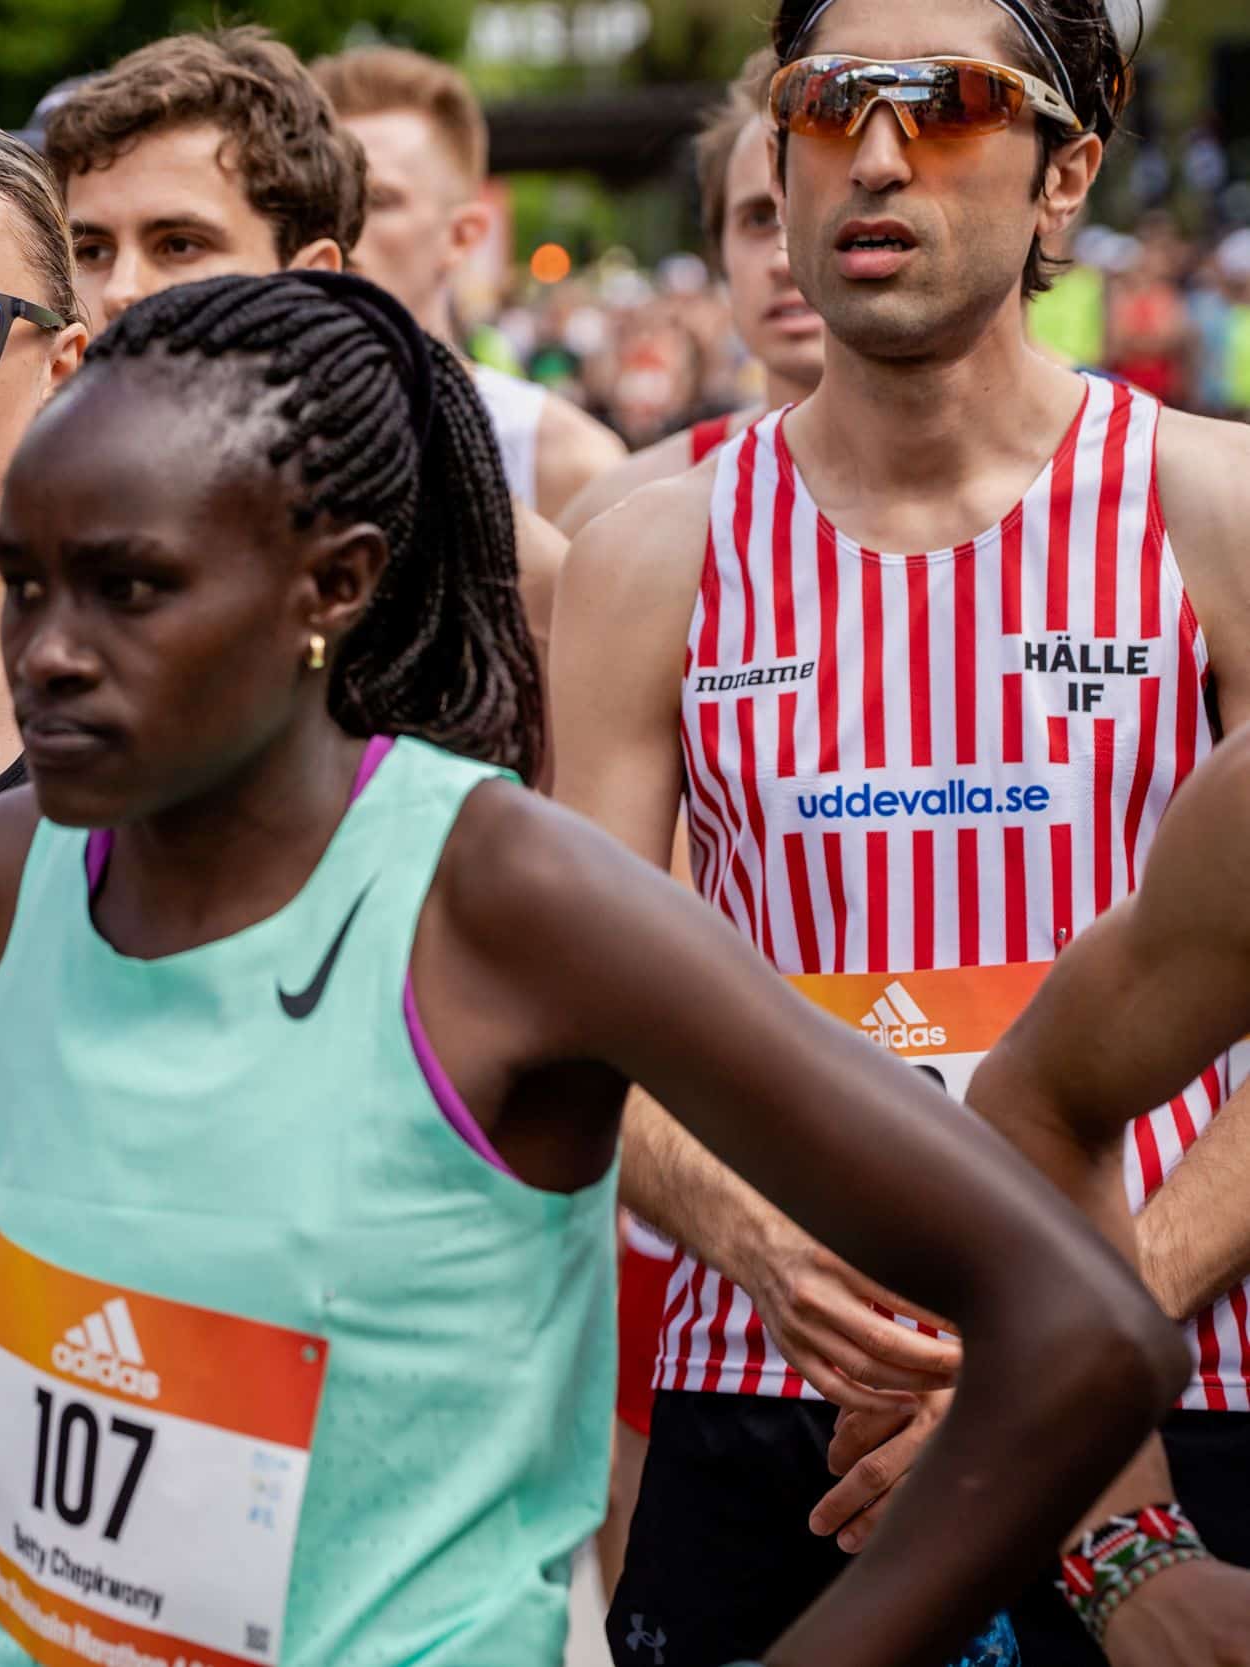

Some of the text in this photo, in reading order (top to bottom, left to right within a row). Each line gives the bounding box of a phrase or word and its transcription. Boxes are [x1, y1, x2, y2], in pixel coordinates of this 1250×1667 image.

[1024, 635, 1149, 675] HÄLLE
[694, 661, 815, 692] noname
[1068, 682, 1104, 712] IF
[798, 779, 1050, 819] uddevalla.se
[52, 1343, 160, 1400] adidas
[33, 1386, 155, 1543] 107
